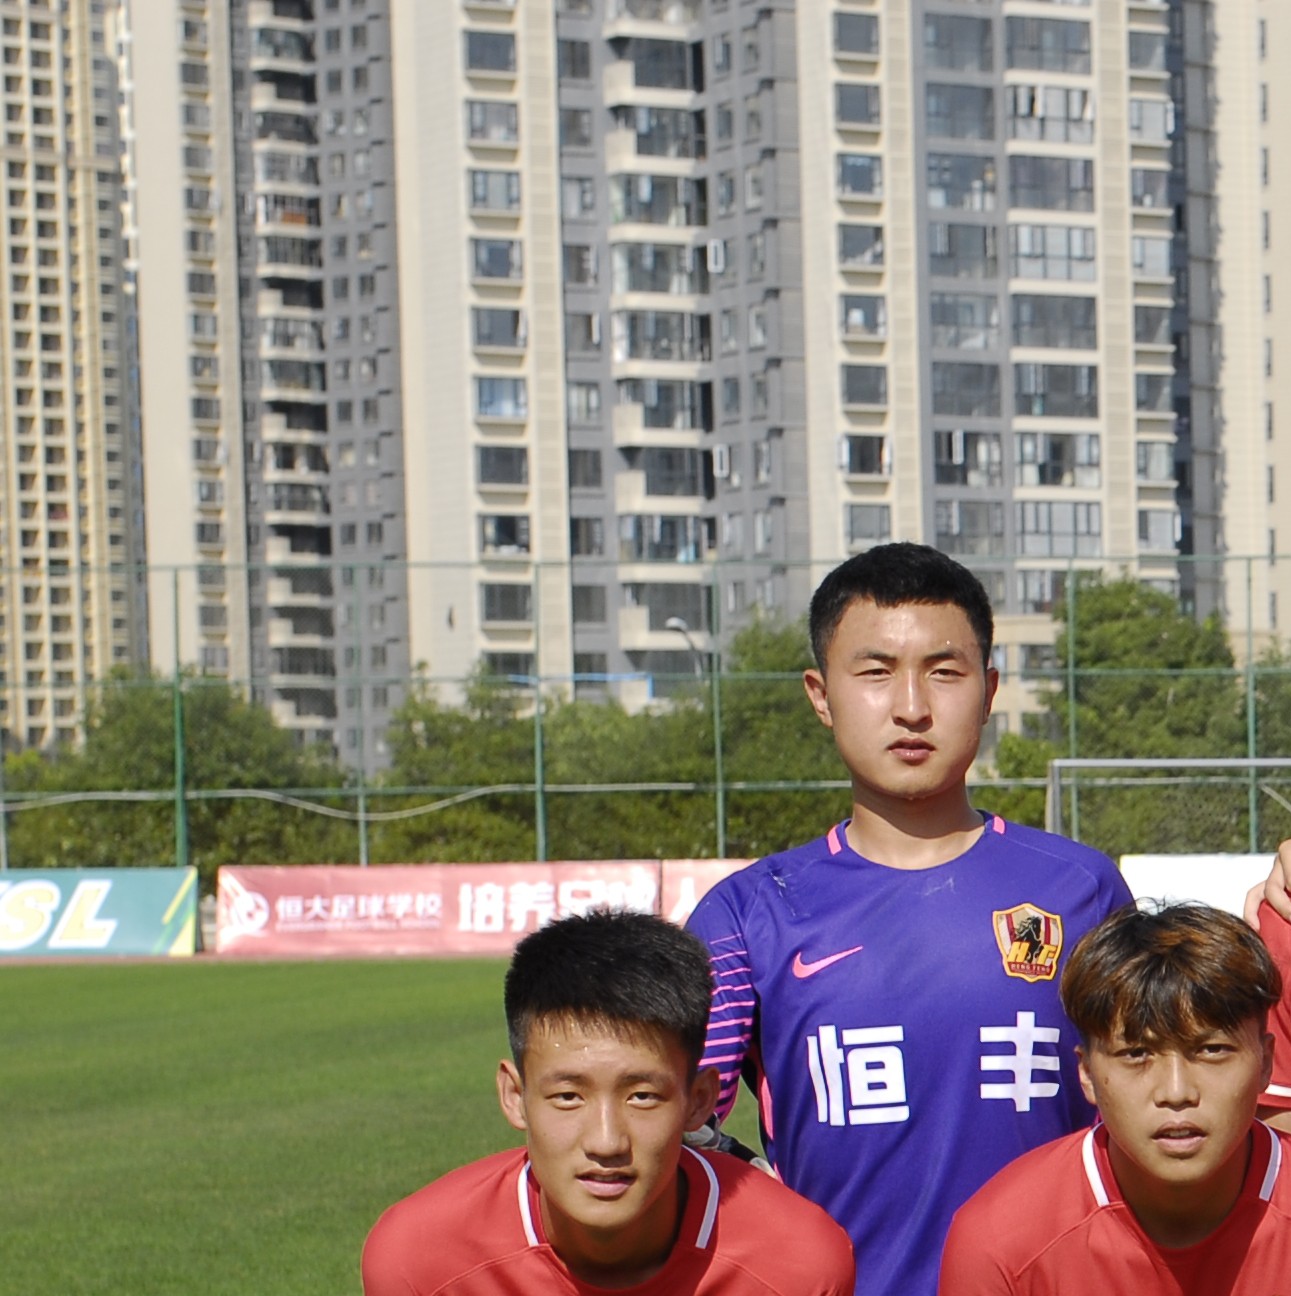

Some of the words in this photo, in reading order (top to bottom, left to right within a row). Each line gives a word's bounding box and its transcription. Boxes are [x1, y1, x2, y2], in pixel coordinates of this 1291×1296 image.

[0, 878, 119, 951] SL
[275, 894, 443, 921] 恒大足球学校
[806, 1010, 1061, 1127] 恒丰
